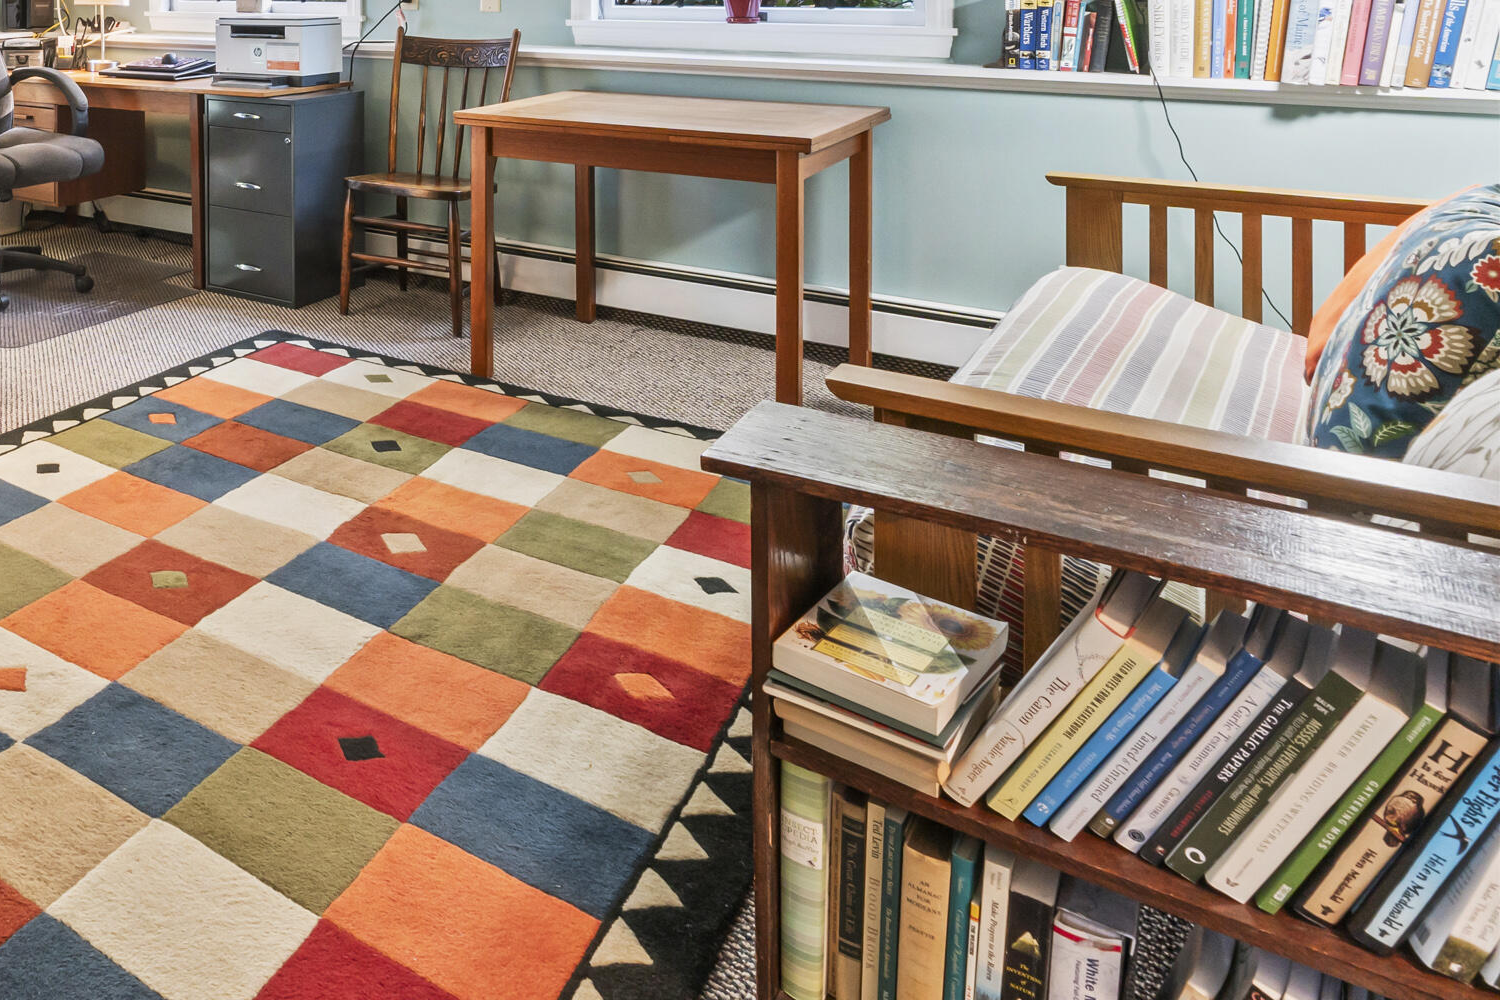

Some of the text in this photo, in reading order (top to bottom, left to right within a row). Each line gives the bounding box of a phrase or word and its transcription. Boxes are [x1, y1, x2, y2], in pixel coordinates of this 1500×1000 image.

[1153, 4, 1164, 38] SIBLEY
[1297, 4, 1309, 14] of
[1416, 9, 1432, 38] Shorebird
[1444, 18, 1455, 27] the
[1445, 11, 1456, 19] of
[1023, 12, 1034, 45] Warblers
[1040, 8, 1050, 49] Western Birds
[1293, 17, 1309, 46] Maine
[1439, 26, 1454, 53] Americas
[1413, 39, 1426, 58] Guide
[1016, 672, 1071, 731] The Canon
[1061, 656, 1137, 741] FIELD NOTES FROM A CATASTROPHE
[1128, 691, 1152, 715] Explain
[1146, 681, 1162, 697] Men
[1243, 694, 1258, 709] A
[1114, 709, 1136, 731] Things
[1221, 702, 1252, 734] Garlic
[1242, 712, 1279, 752] GARLIC
[1289, 715, 1323, 751] MOSSES,
[1404, 713, 1432, 745] Kimmerer
[1103, 731, 1115, 743] Me
[1187, 726, 1231, 774] Testament
[963, 730, 1017, 786] Natalie Angier
[1016, 741, 1063, 793] ELIZABETH KOLBERT
[1089, 729, 1157, 804] Tamed Untamed
[1214, 745, 1250, 785] PAPERS
[1255, 741, 1301, 790] LIVERWORTS,
[1427, 739, 1473, 775] H
[1248, 782, 1266, 800] and
[1254, 711, 1378, 858] KIMMERER BRAIDING SWEETGRASS
[1408, 768, 1447, 795] Hawk
[1432, 767, 1453, 784] for
[1215, 792, 1257, 837] HORNWORTS
[1315, 777, 1379, 852] GATHERING MOSS
[1450, 782, 1499, 832] Flights
[846, 840, 857, 857] The
[870, 819, 883, 858] Ted Levin
[907, 882, 942, 900] ALMANAC
[1328, 846, 1378, 905] Helen Macdonald
[1381, 850, 1448, 933] Helen Macdonald
[865, 876, 880, 970] BLOOD BROOK
[990, 899, 999, 919] Make
[986, 918, 997, 942] Prayers
[985, 960, 994, 981] Raven
[986, 949, 996, 960] the
[1086, 957, 1100, 992] White
